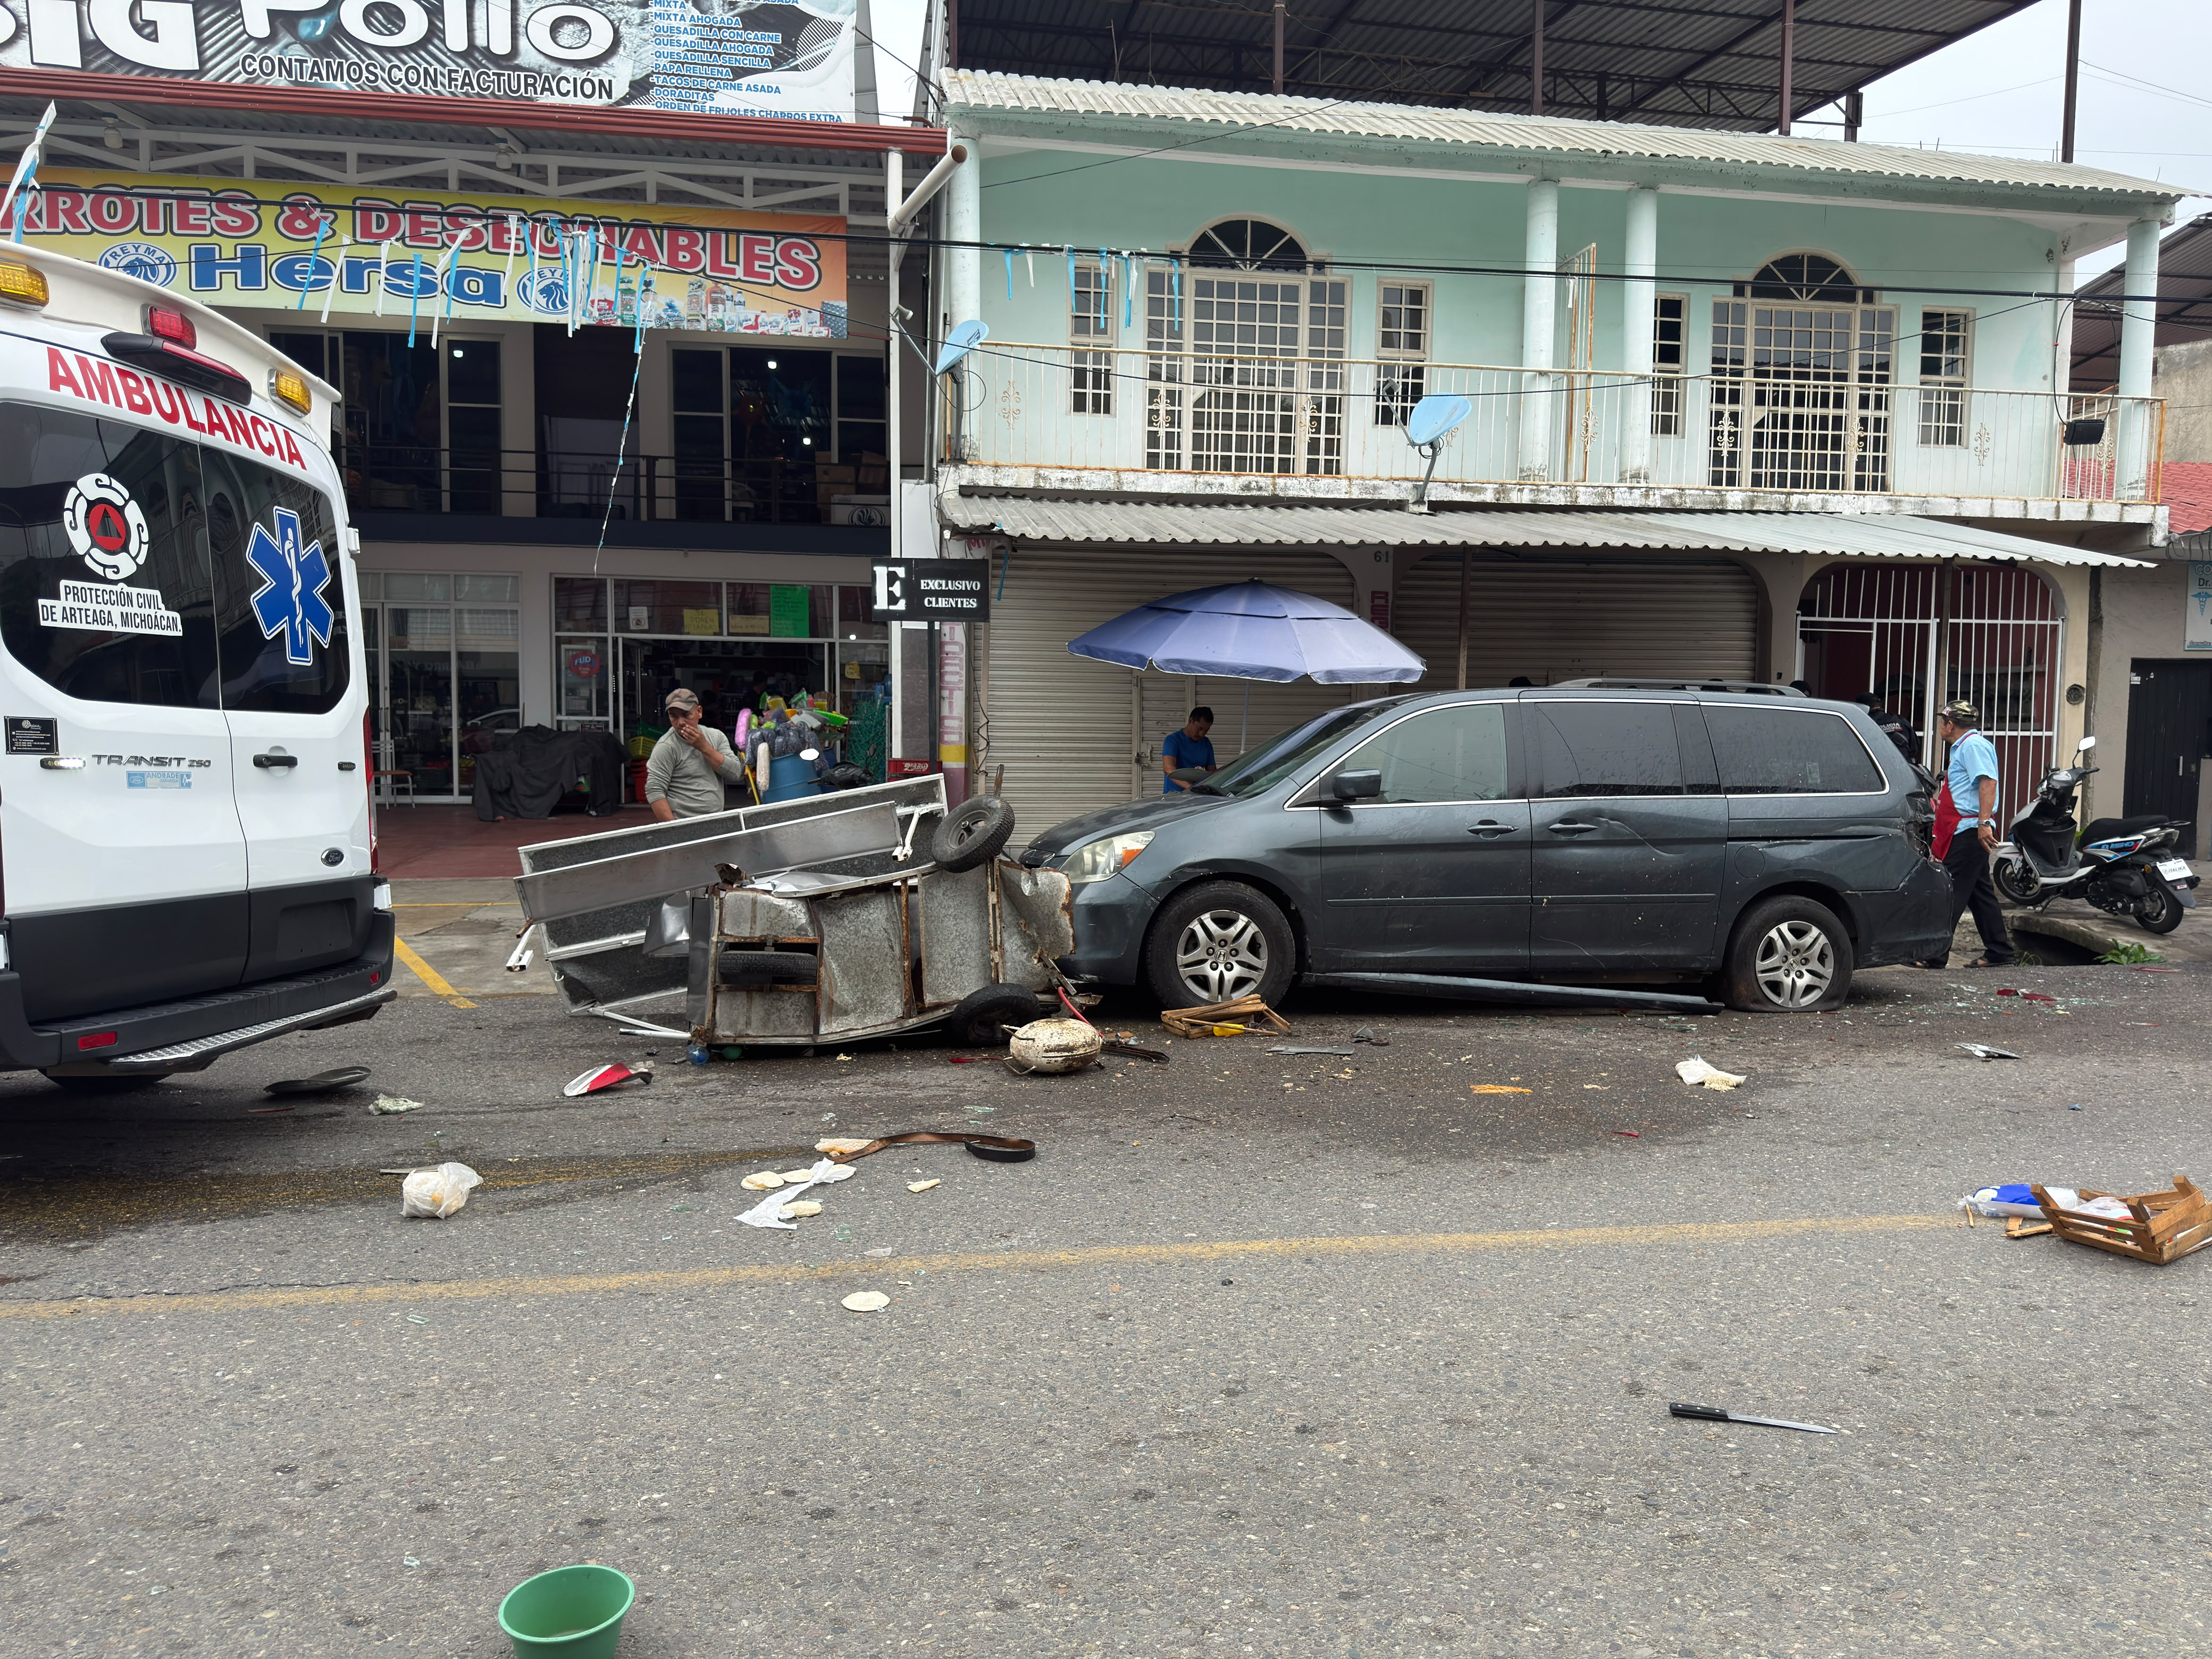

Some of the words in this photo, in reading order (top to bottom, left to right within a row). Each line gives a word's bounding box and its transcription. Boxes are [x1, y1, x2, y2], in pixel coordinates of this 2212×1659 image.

[689, 15, 741, 27] AHOGADA
[650, 25, 719, 38] -QUESADILLA
[722, 30, 743, 40] CON
[745, 32, 781, 43] CARNE
[650, 38, 719, 50] -QUESADILLA
[722, 44, 774, 55] AHOGADA
[650, 51, 719, 63] -QUESADILLA
[721, 56, 771, 68] SENCILLA
[241, 54, 380, 85] CONTAMOS
[387, 63, 439, 90] CON
[447, 69, 613, 100] FACTURACIÓN
[685, 65, 731, 78] RELLENA
[692, 79, 706, 88] DE
[708, 81, 743, 91] CARNE
[745, 83, 781, 94] ASADA
[693, 104, 707, 113] DE
[709, 106, 756, 116] FRIJOLES
[758, 110, 807, 120] CHARROS
[809, 113, 842, 123] EXTRA
[277, 192, 336, 241] &
[108, 244, 166, 264] REYMA
[188, 243, 506, 308] Hersa
[655, 316, 685, 328] Bimbollos
[46, 346, 307, 471] AMBULANCIA
[874, 566, 906, 610] E
[920, 579, 981, 591] EXCLUSIVO
[2198, 577, 2212, 586] Dr.
[64, 584, 134, 608] PROTECCIÓN
[136, 592, 162, 610] CIVIL
[924, 597, 978, 608] CLIENTES
[41, 604, 57, 622] DE
[61, 606, 118, 629] ARTEAGA,
[120, 611, 181, 632] MICHOÁCAN.
[574, 656, 591, 666] FUD
[91, 754, 186, 767] TRANSIT
[188, 759, 212, 767] 250
[329, 852, 341, 862] Ford
